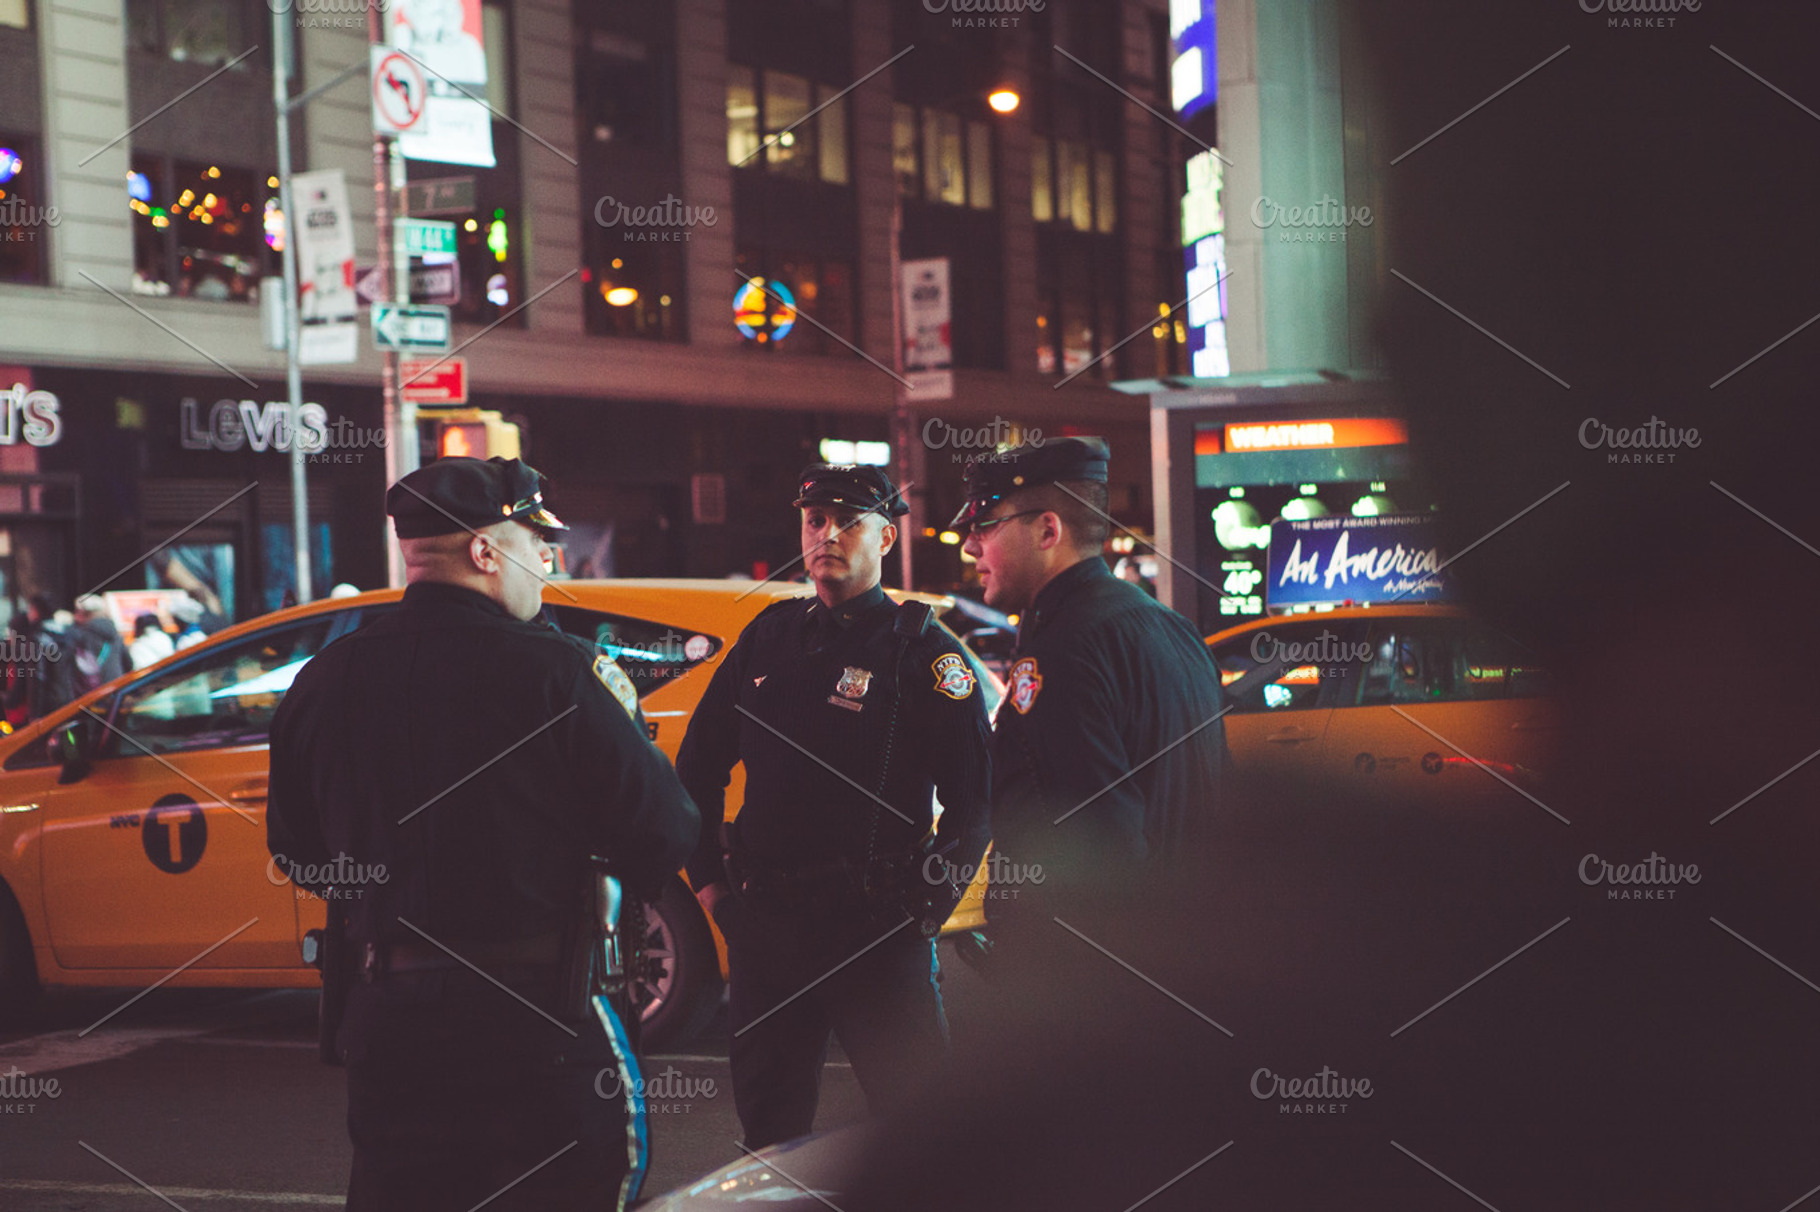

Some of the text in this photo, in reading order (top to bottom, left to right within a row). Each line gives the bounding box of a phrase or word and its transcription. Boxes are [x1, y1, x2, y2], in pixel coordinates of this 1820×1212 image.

[1230, 423, 1334, 449] WEATHER
[1280, 530, 1443, 589] An America
[157, 809, 192, 863] T
